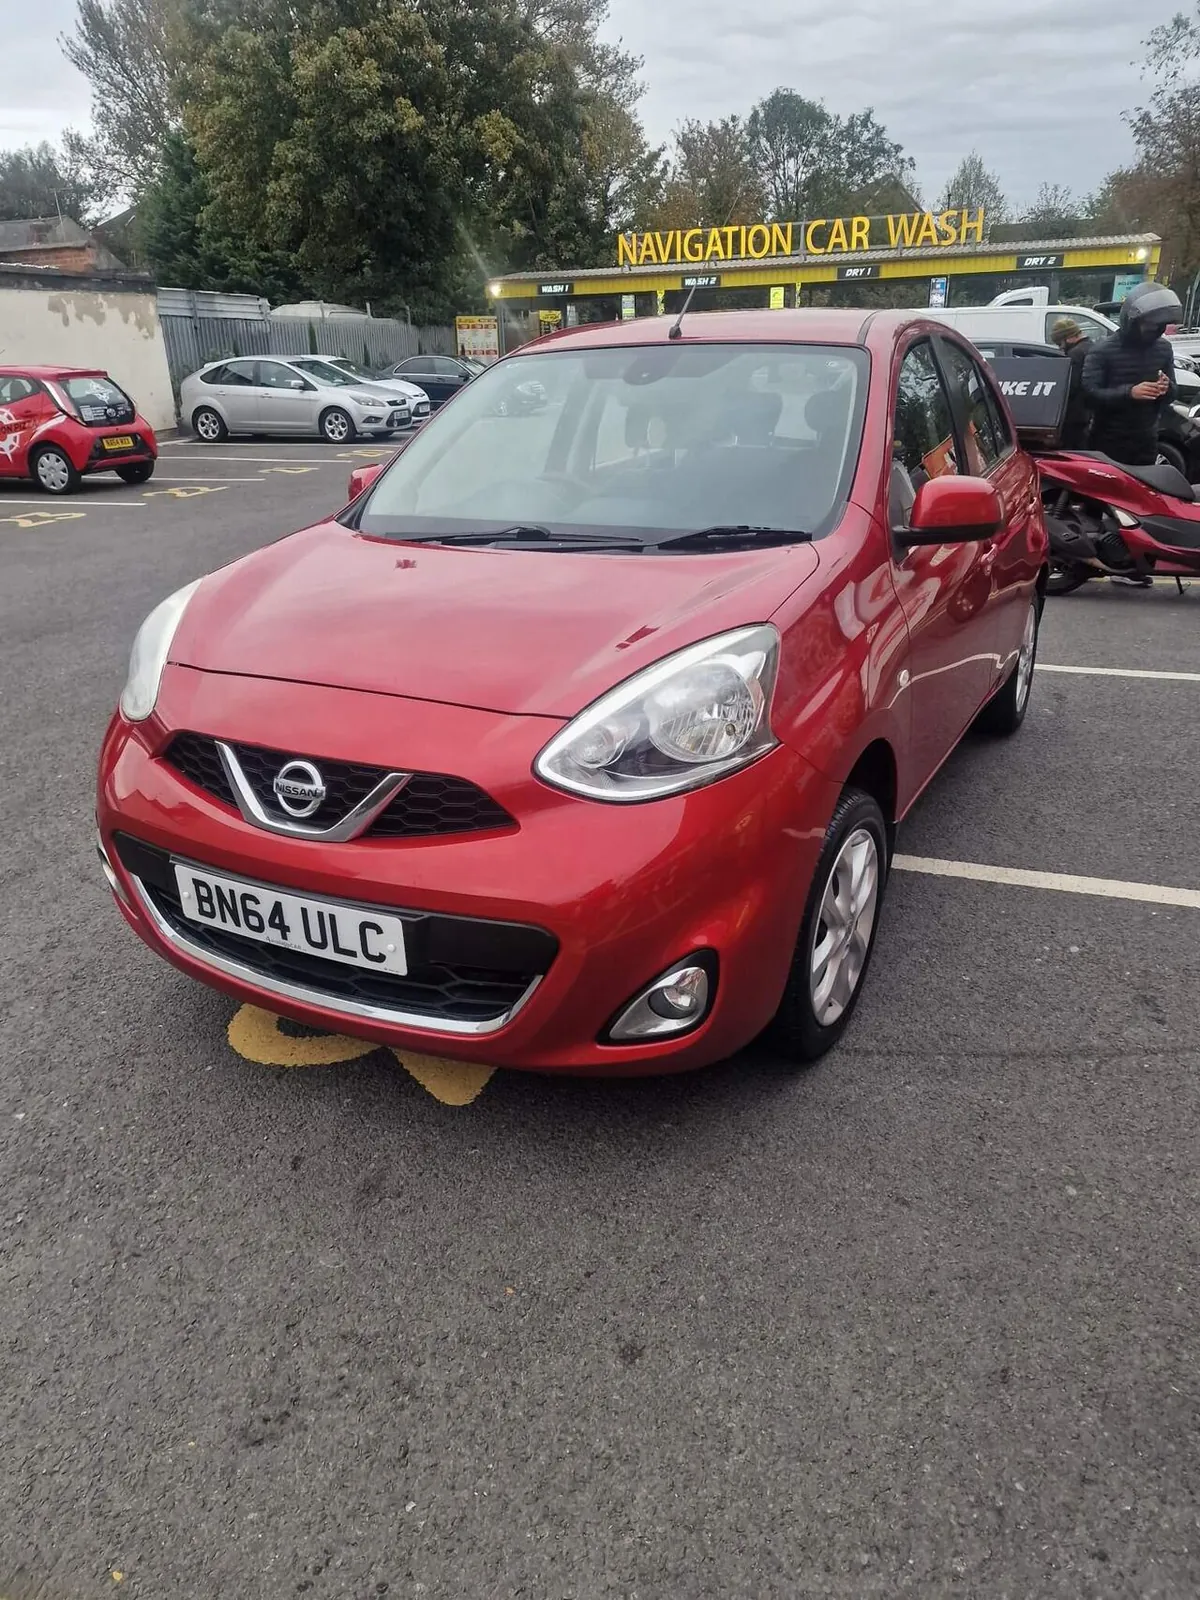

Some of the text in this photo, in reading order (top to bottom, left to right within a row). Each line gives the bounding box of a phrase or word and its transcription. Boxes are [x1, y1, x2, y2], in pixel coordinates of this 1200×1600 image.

[618, 207, 985, 266] NAVIGATION CAR WASH
[1023, 256, 1056, 266] DRY 2
[845, 267, 865, 277] DRY
[684, 276, 717, 286] WASH 2
[541, 284, 564, 293] WASH
[998, 381, 1057, 396] KE IT
[275, 782, 318, 797] NISSAN
[191, 877, 387, 964] BN64 ULC
